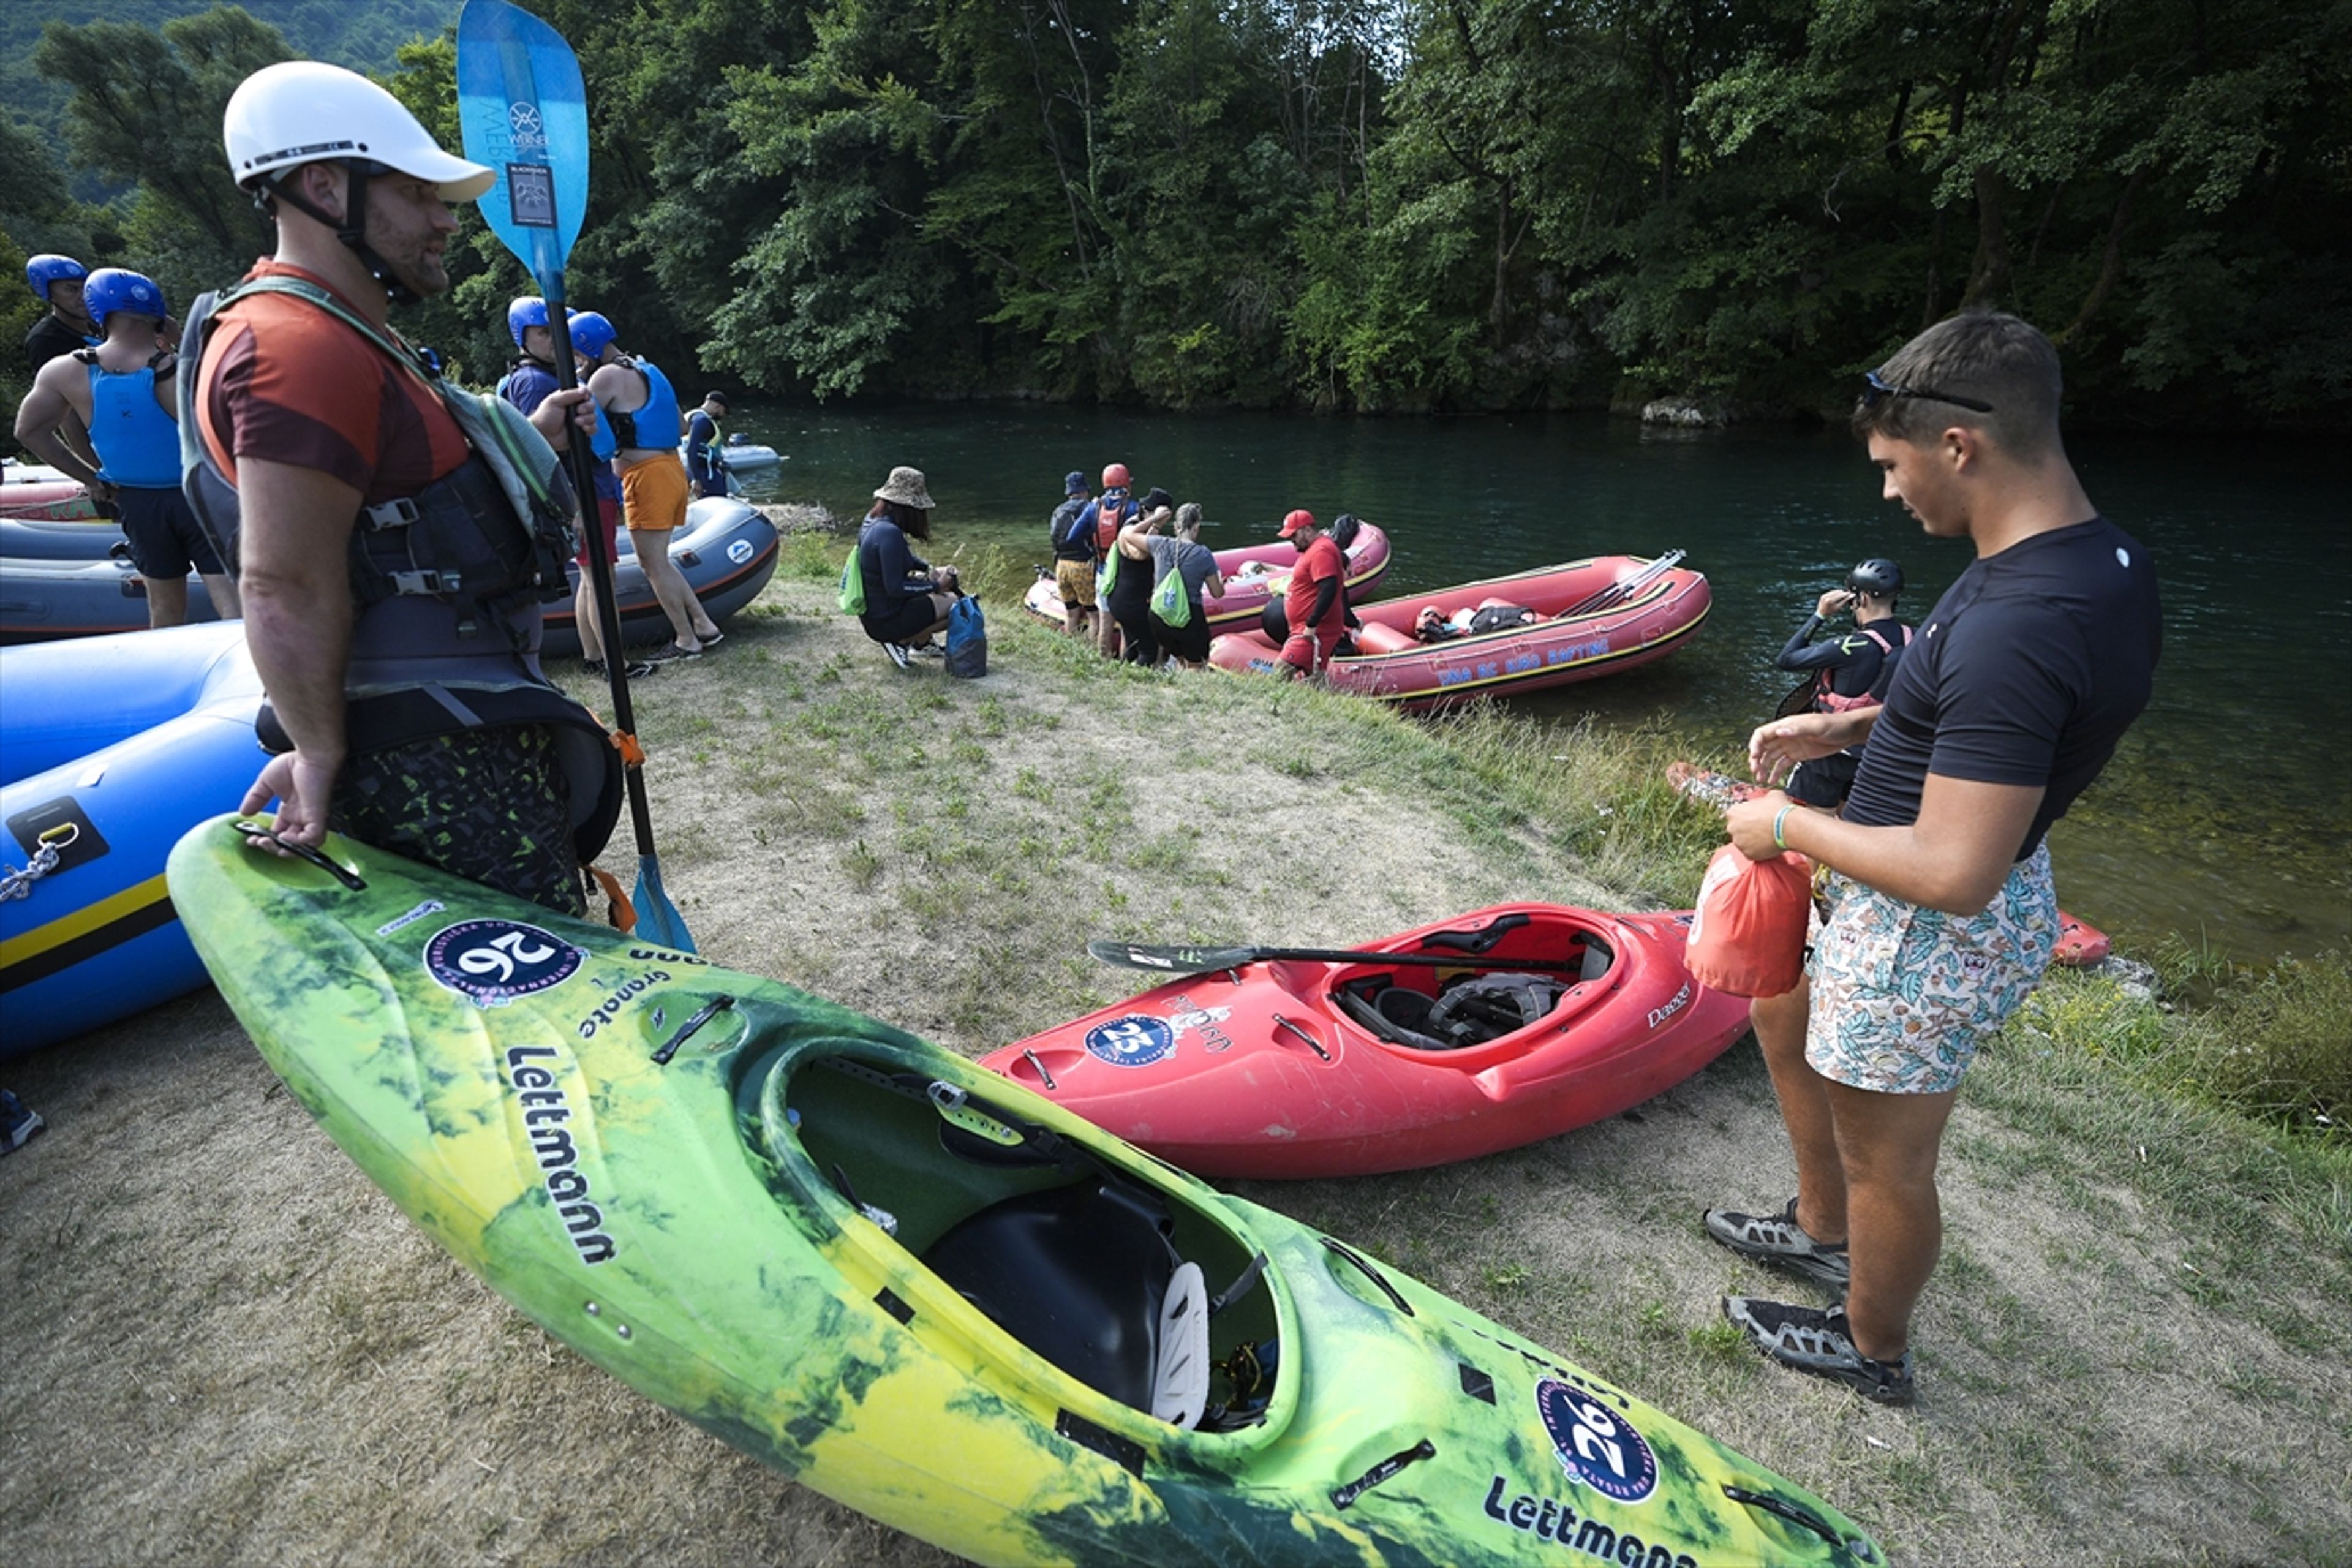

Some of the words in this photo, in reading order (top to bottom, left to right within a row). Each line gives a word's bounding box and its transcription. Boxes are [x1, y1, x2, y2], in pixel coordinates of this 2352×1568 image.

[1438, 666, 1472, 686] UNA
[1548, 639, 1610, 665] RAFTING
[459, 930, 556, 982] 26
[508, 1048, 616, 1264] Lettmann
[1563, 1395, 1626, 1479] 26
